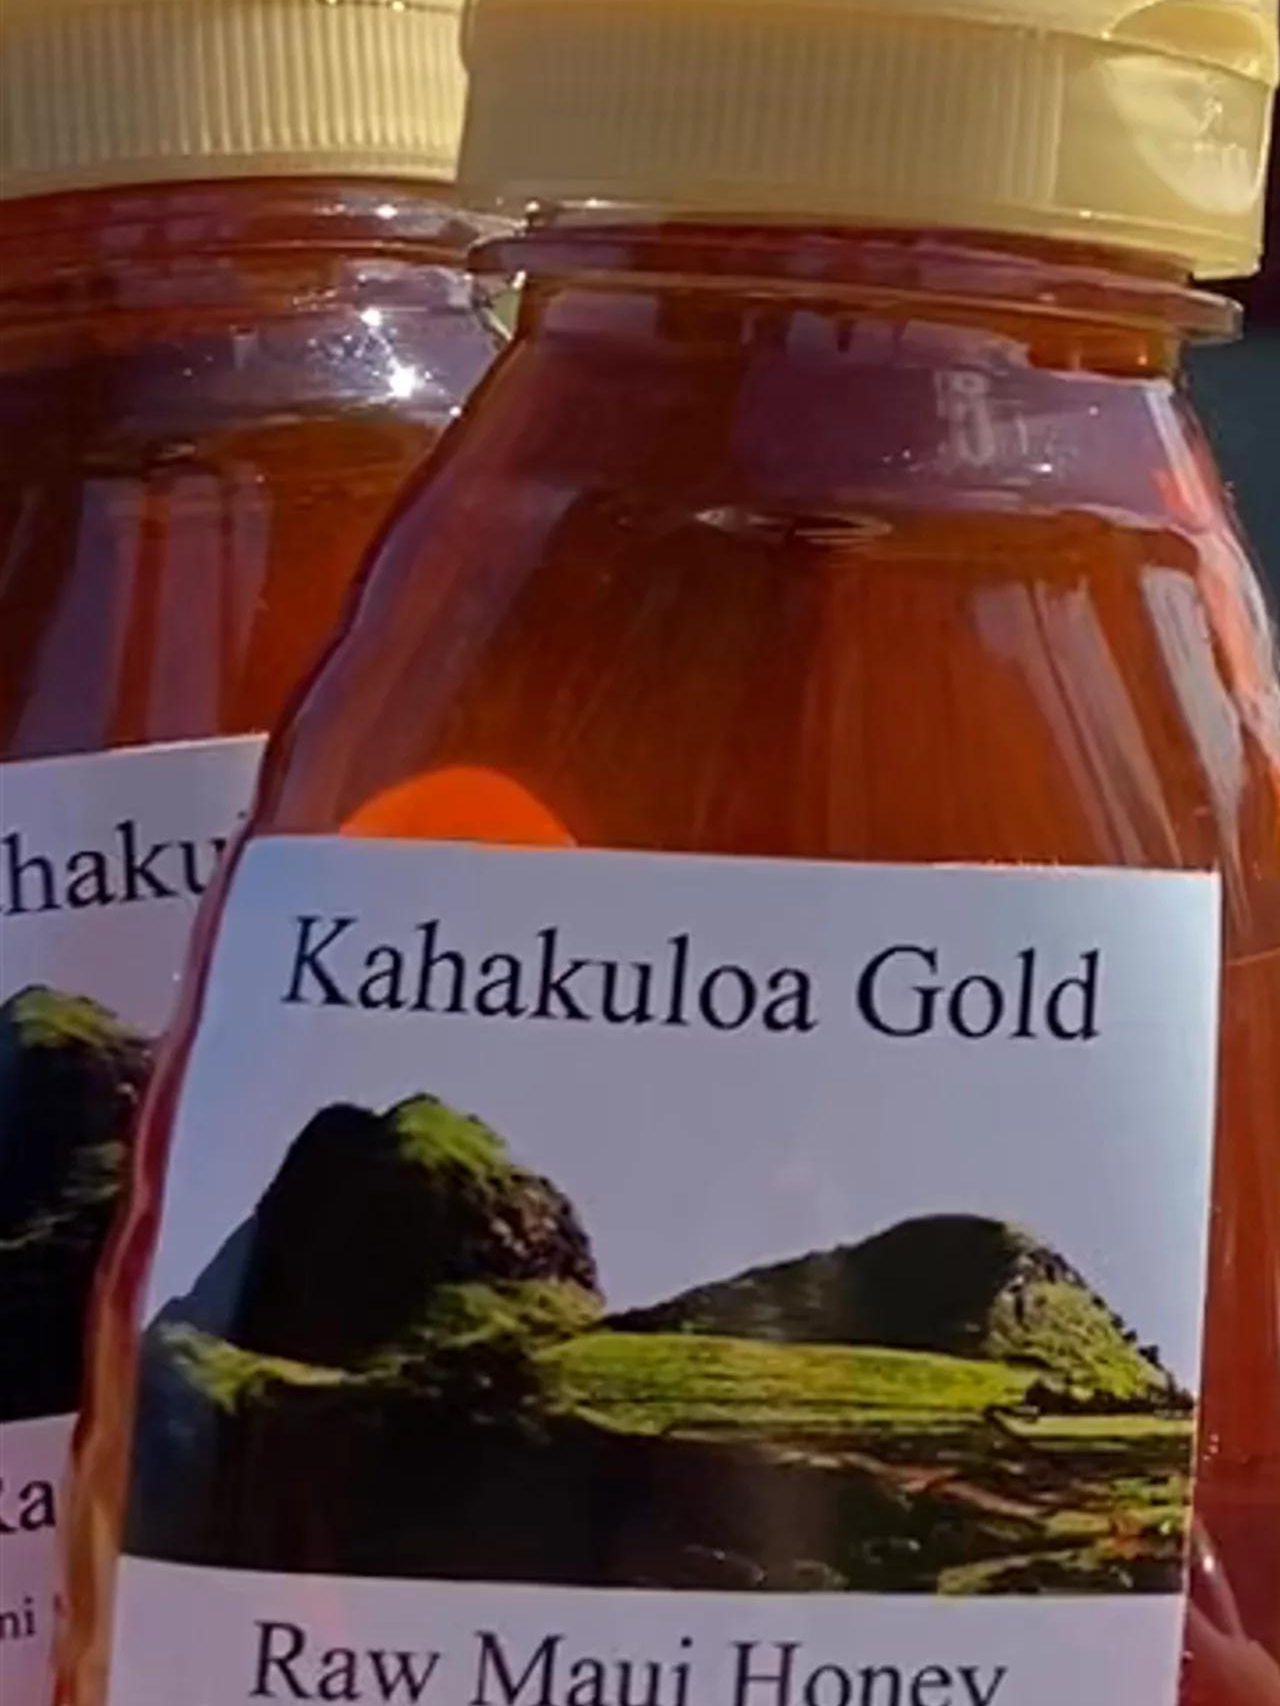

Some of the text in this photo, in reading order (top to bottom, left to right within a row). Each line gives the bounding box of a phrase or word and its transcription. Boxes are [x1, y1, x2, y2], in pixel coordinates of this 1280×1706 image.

[281, 913, 1102, 1041] Kahakuloa Gold
[248, 1619, 442, 1705] Raw
